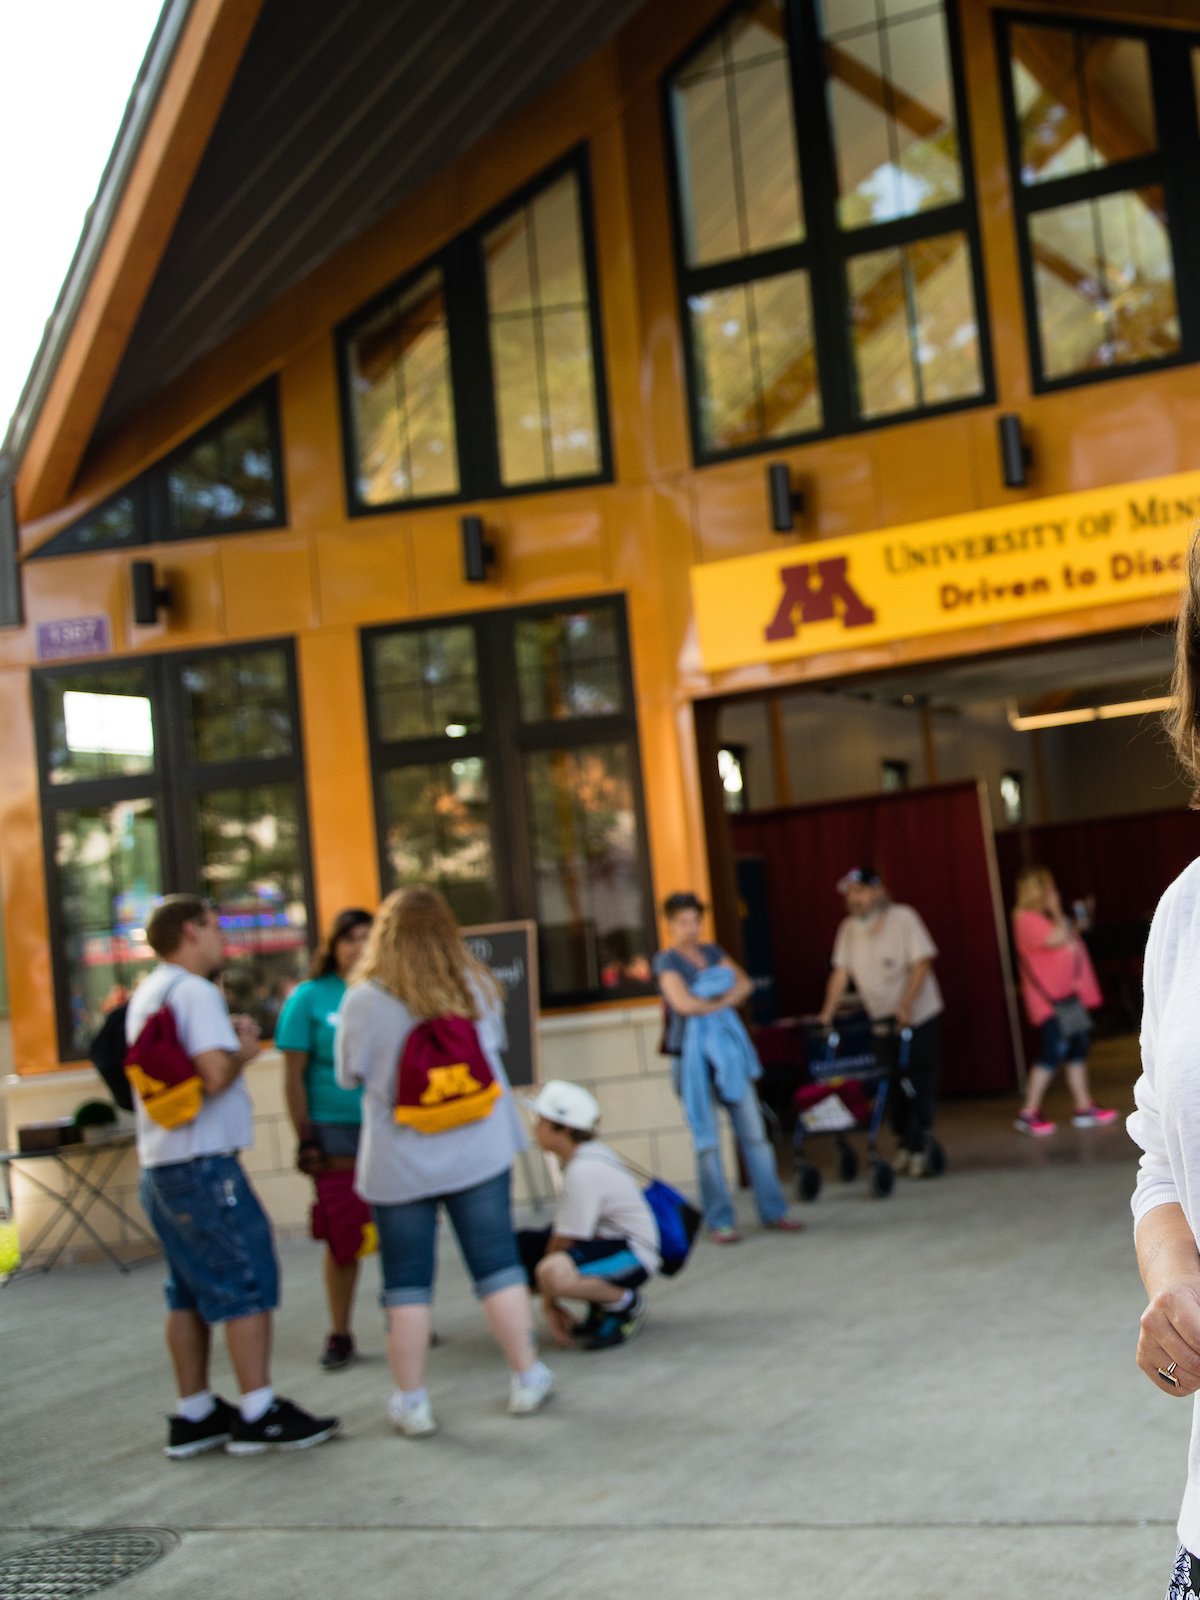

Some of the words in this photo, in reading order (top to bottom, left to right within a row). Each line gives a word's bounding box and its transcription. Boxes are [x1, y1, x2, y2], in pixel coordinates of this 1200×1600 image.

[883, 519, 1068, 576] UNIVERSITY
[1077, 512, 1116, 541] OF
[939, 577, 1049, 612] Driven
[1063, 563, 1098, 589] to
[1110, 551, 1182, 582] Disc
